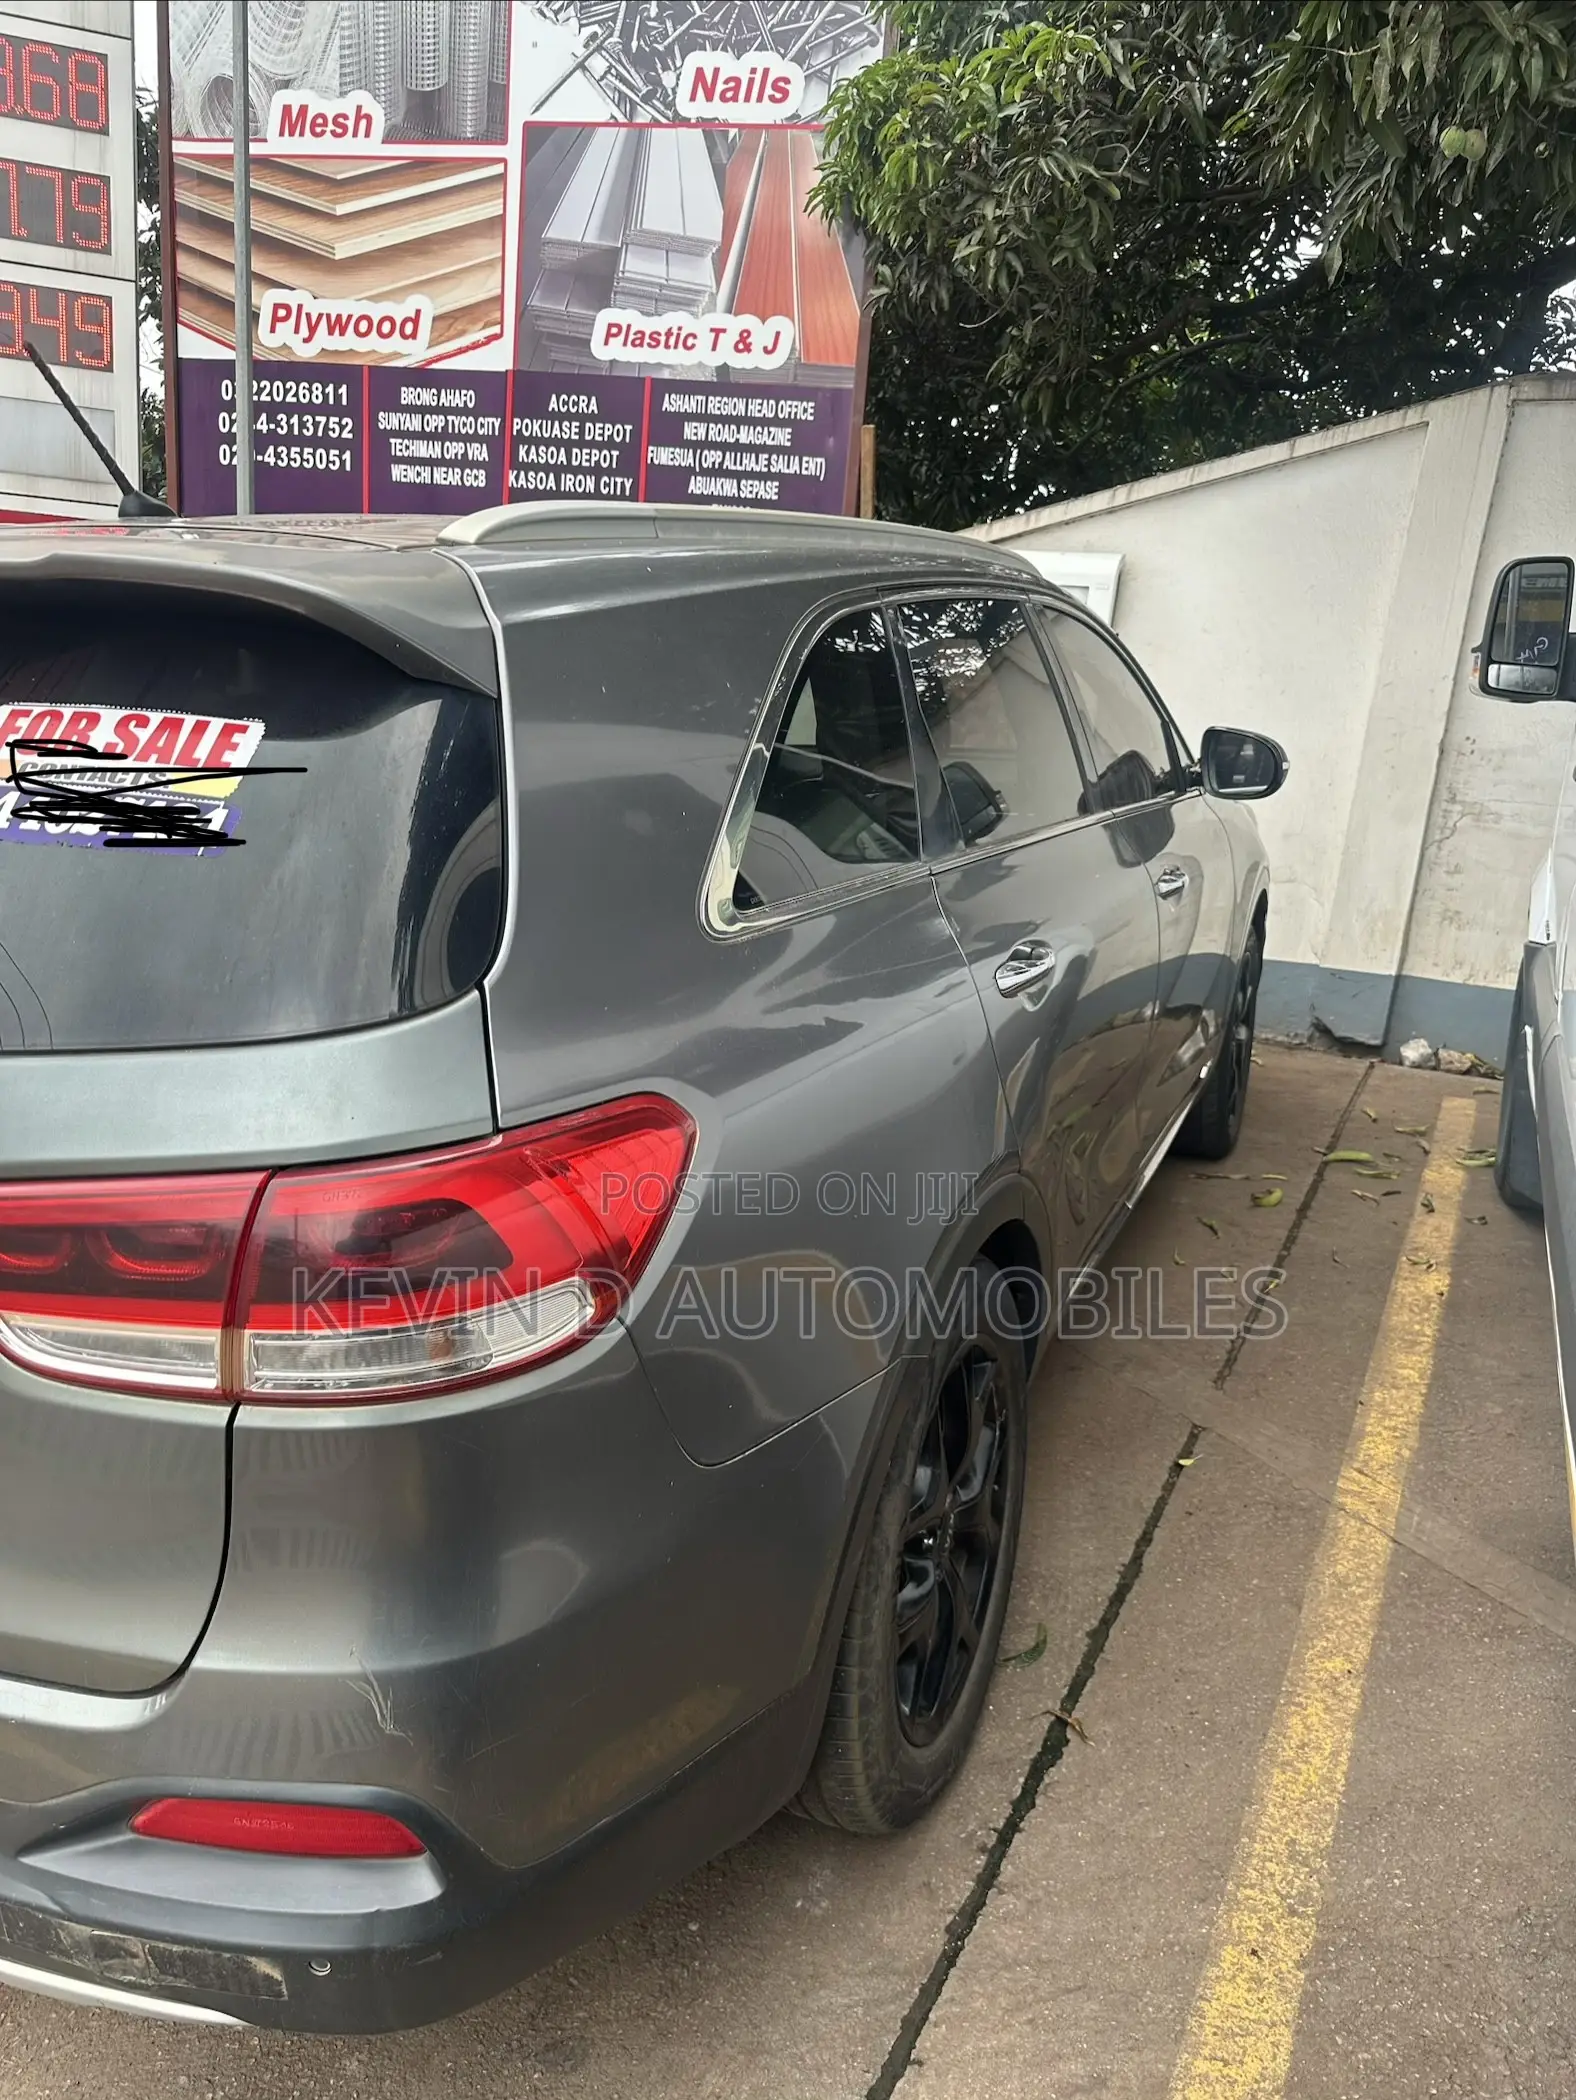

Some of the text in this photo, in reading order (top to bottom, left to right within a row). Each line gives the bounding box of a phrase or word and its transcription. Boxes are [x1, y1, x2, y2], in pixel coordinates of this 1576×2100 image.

[689, 66, 792, 104] Nails
[278, 104, 374, 139] Mesh
[269, 302, 422, 344] Plywood
[603, 322, 781, 355] Plastic T & J
[221, 379, 348, 406] 02026811
[400, 386, 476, 408] BRONG AHAFO
[548, 393, 599, 414] ACCRA
[662, 393, 815, 421] ASHANTI REGION HEAD OFFICE
[218, 411, 354, 439] 04-313752
[377, 411, 502, 436] SUNYANI OPP TYCO CITY
[512, 418, 634, 443] POKUASE DEPOT
[683, 421, 793, 447] NEW ROAD-MAGAZINE
[218, 443, 352, 472] 0-4355051
[389, 438, 489, 462] TECHIMAN OPP VRA
[518, 444, 620, 469] KASOA DEPOT
[391, 464, 487, 488] WENCHI NEAR GCB
[647, 446, 695, 468] FUMESUA
[723, 452, 769, 474] ALLHAJE
[769, 455, 801, 476] SALIA
[801, 457, 826, 482] ENT)
[508, 469, 633, 497] KASOA IRON CITY
[688, 476, 779, 500] ABUAKWA SEPASE
[0, 709, 249, 768] FOR SALE
